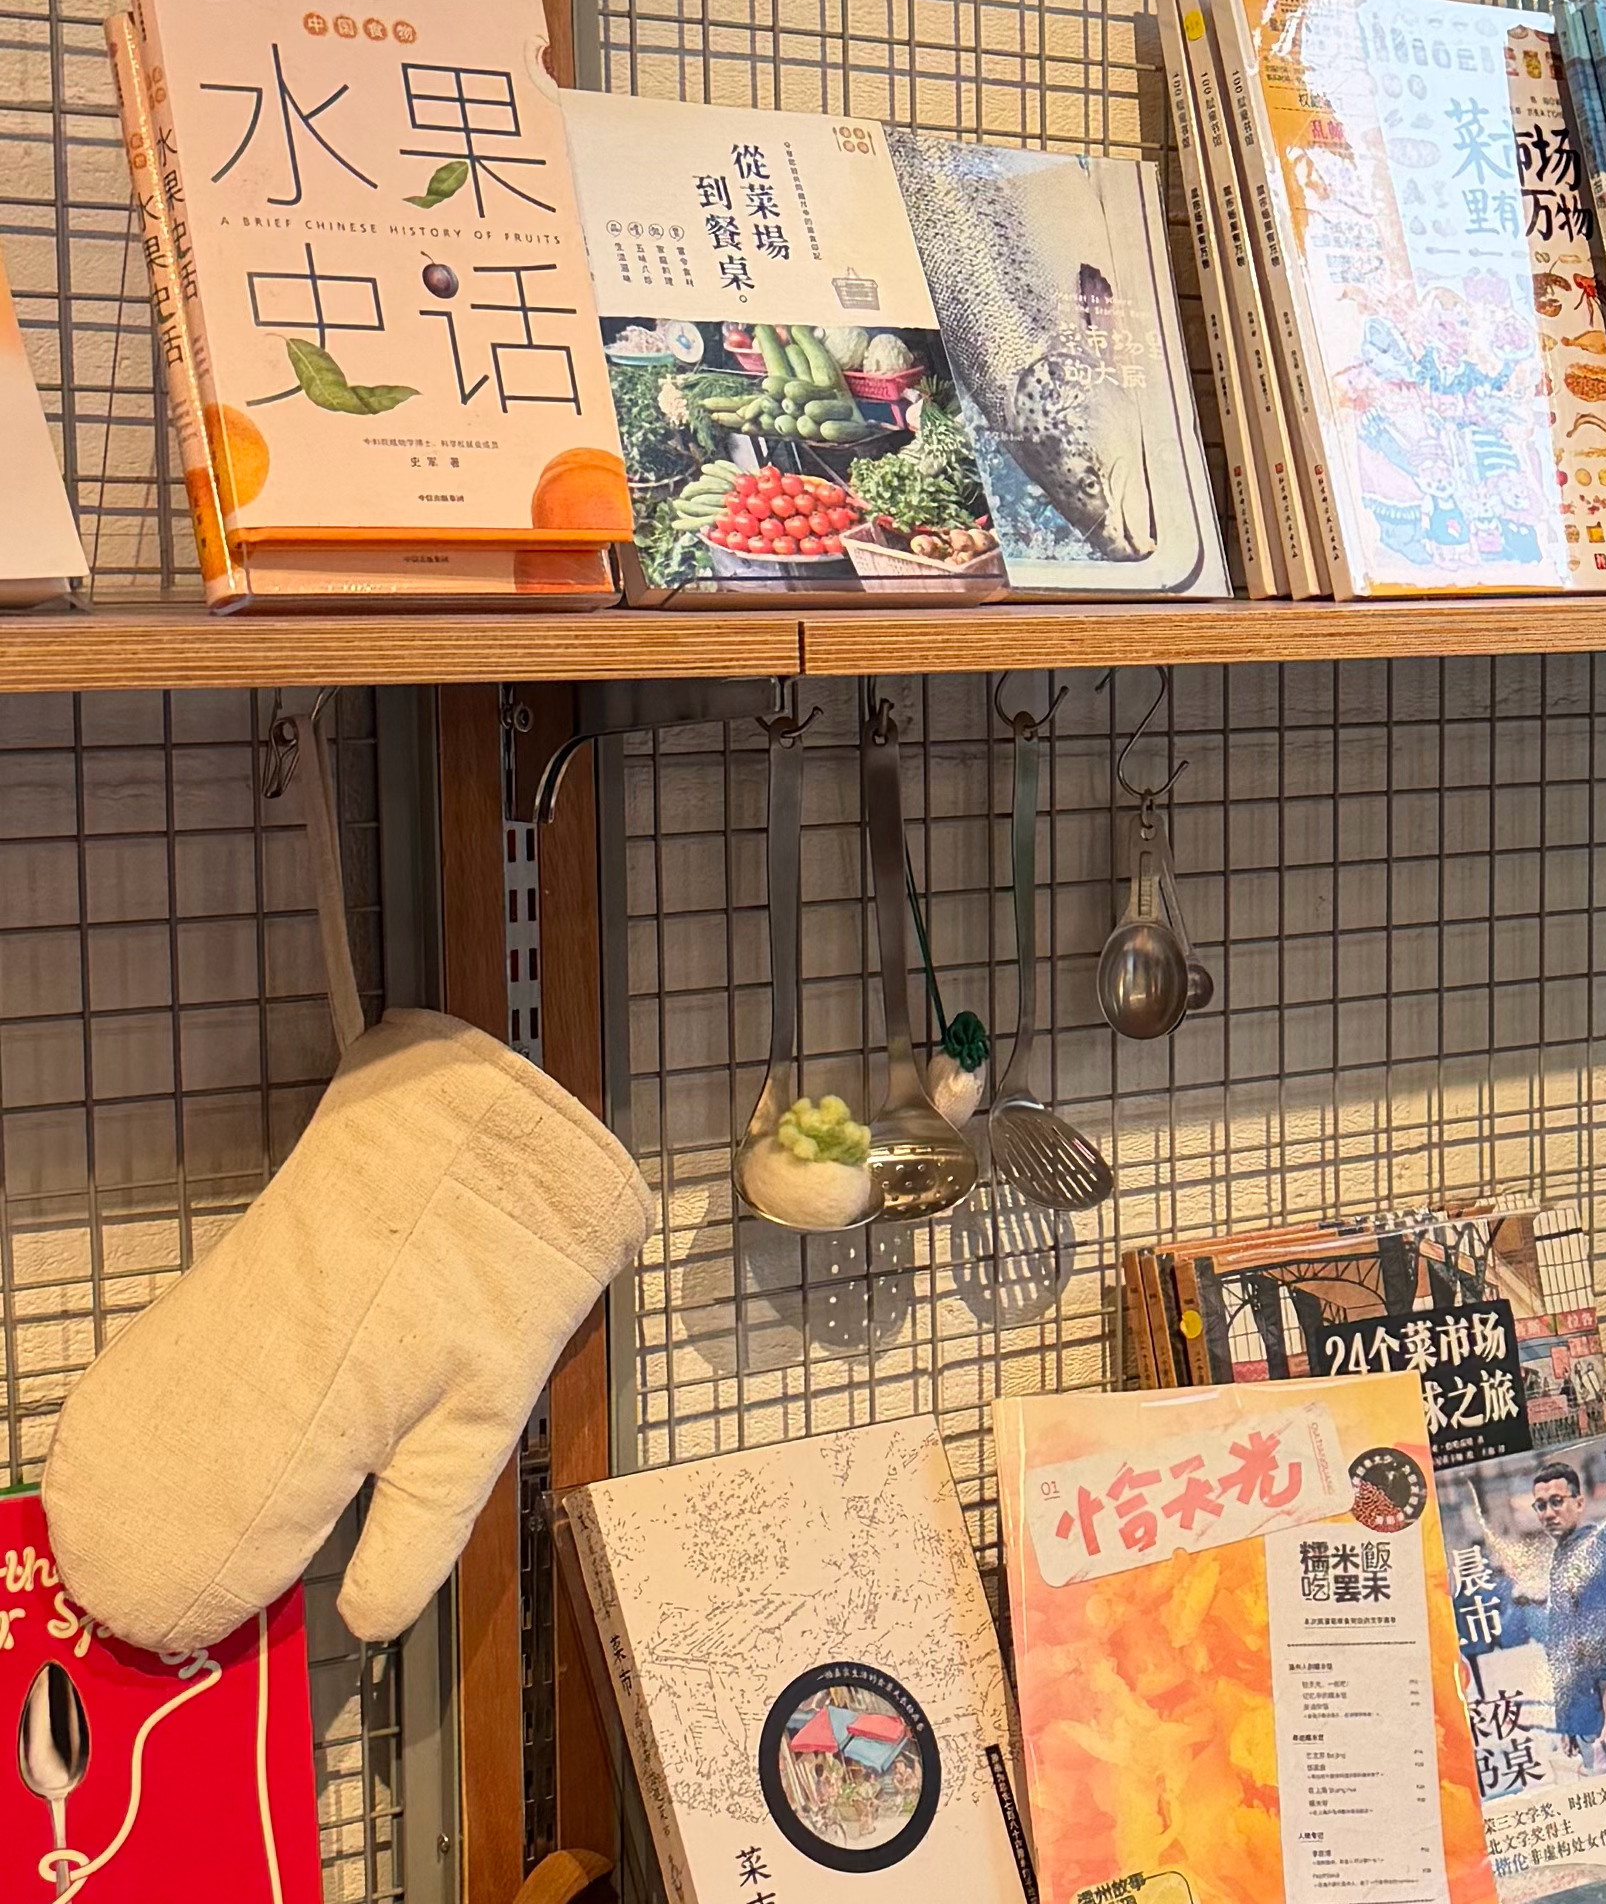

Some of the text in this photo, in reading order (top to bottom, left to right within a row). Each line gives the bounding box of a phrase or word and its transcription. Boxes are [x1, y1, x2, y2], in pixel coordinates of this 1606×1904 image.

[304, 13, 416, 43] 中国食物
[199, 42, 557, 219] 水果
[731, 143, 791, 262] 從菜場
[1461, 187, 1594, 243] 里有万物
[220, 217, 563, 245] A BRIEF CHINESE HISTORY OF FRUITS
[245, 242, 585, 417] 史话
[1039, 1480, 1060, 1497] 01
[1056, 1429, 1304, 1559] 恰天光
[1299, 1540, 1393, 1575] 糯米飯
